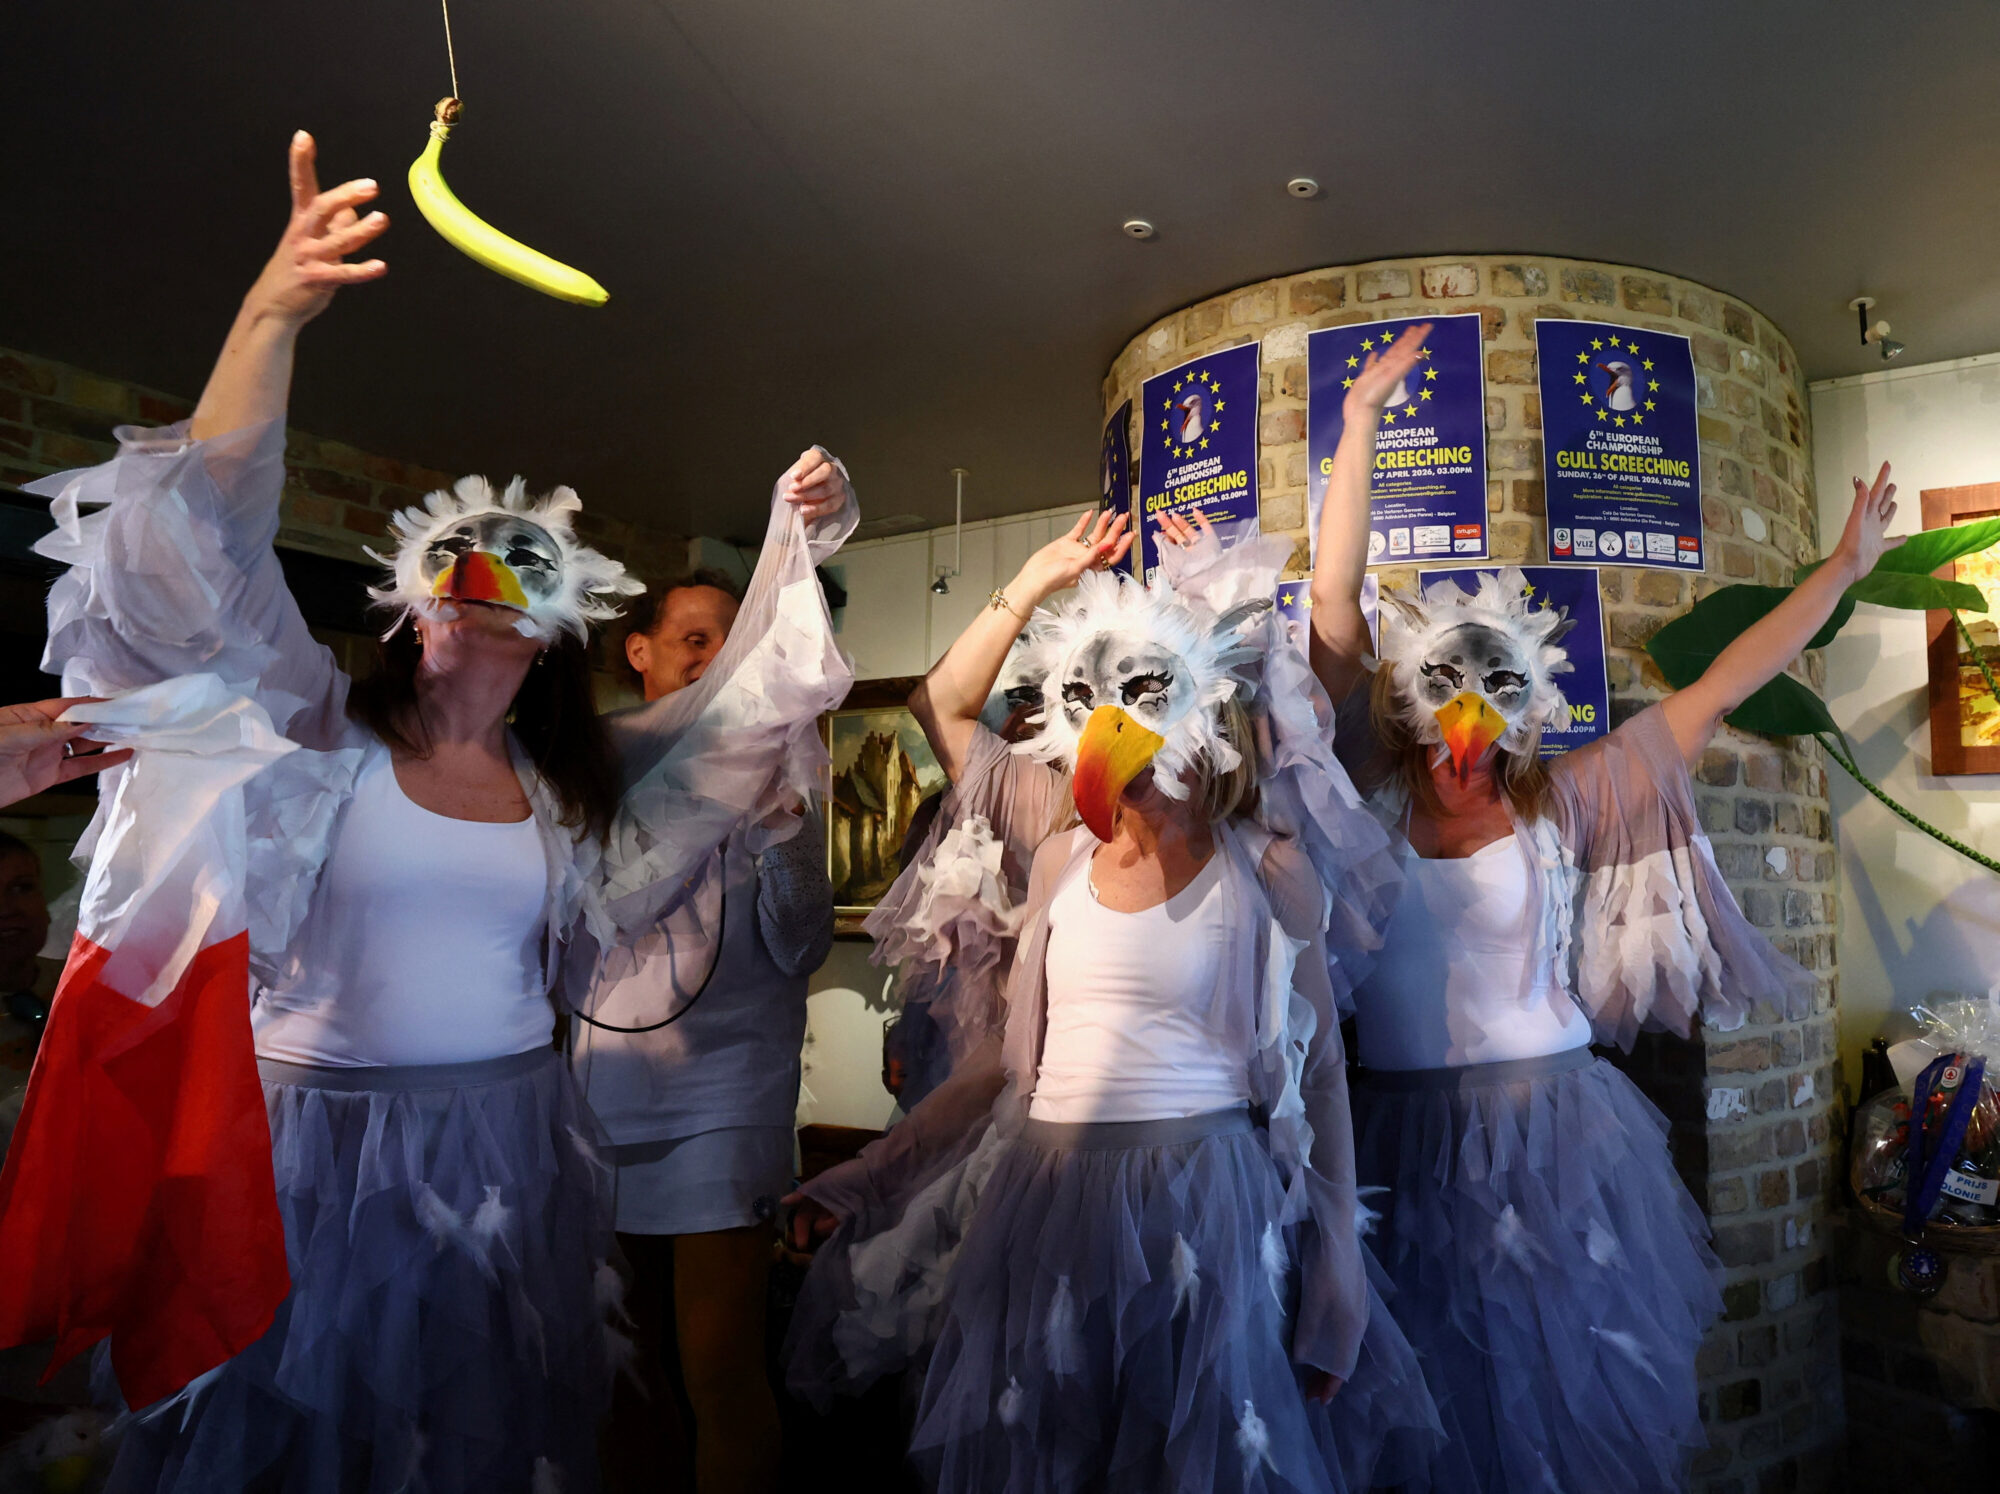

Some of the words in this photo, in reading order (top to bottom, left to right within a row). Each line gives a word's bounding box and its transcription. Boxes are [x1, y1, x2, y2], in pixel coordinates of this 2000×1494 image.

[1375, 427, 1434, 441] EUROPEAN
[1589, 430, 1604, 439] 6TH
[1606, 432, 1659, 445] EUROPEAN
[1375, 436, 1439, 450] MPIONSHIP
[1586, 440, 1663, 455] CHAMPIONSHIP
[1372, 446, 1472, 470] CREECHING
[1556, 450, 1597, 469] GULL
[1600, 453, 1690, 478] SCREECHING
[1167, 467, 1178, 479] 6TH
[1178, 456, 1221, 476] EUROPEAN
[1373, 470, 1384, 479] OF
[1386, 470, 1410, 479] APRIL
[1412, 468, 1435, 477] 2026,
[1437, 467, 1472, 475] 03.00PM
[1164, 464, 1223, 489] CHAMPIONSHIP
[1557, 470, 1592, 480] SUNDAY,
[1607, 473, 1618, 481] OF
[1619, 474, 1640, 483] APRIL
[1642, 476, 1662, 485] 2026,
[1663, 478, 1690, 488] 03.00PM
[1146, 491, 1172, 513] GULL
[1174, 470, 1247, 504] SCREECHING
[1178, 504, 1186, 512] OF
[1186, 499, 1203, 510] APRIL
[1203, 495, 1220, 506] 2026,
[1221, 490, 1248, 501] 03.00PM
[1576, 540, 1594, 548] VLIZ
[1566, 726, 1596, 734] 3.00PM
[1956, 1176, 1988, 1190] PRIJS
[1941, 1183, 1981, 1201] OLONIE
